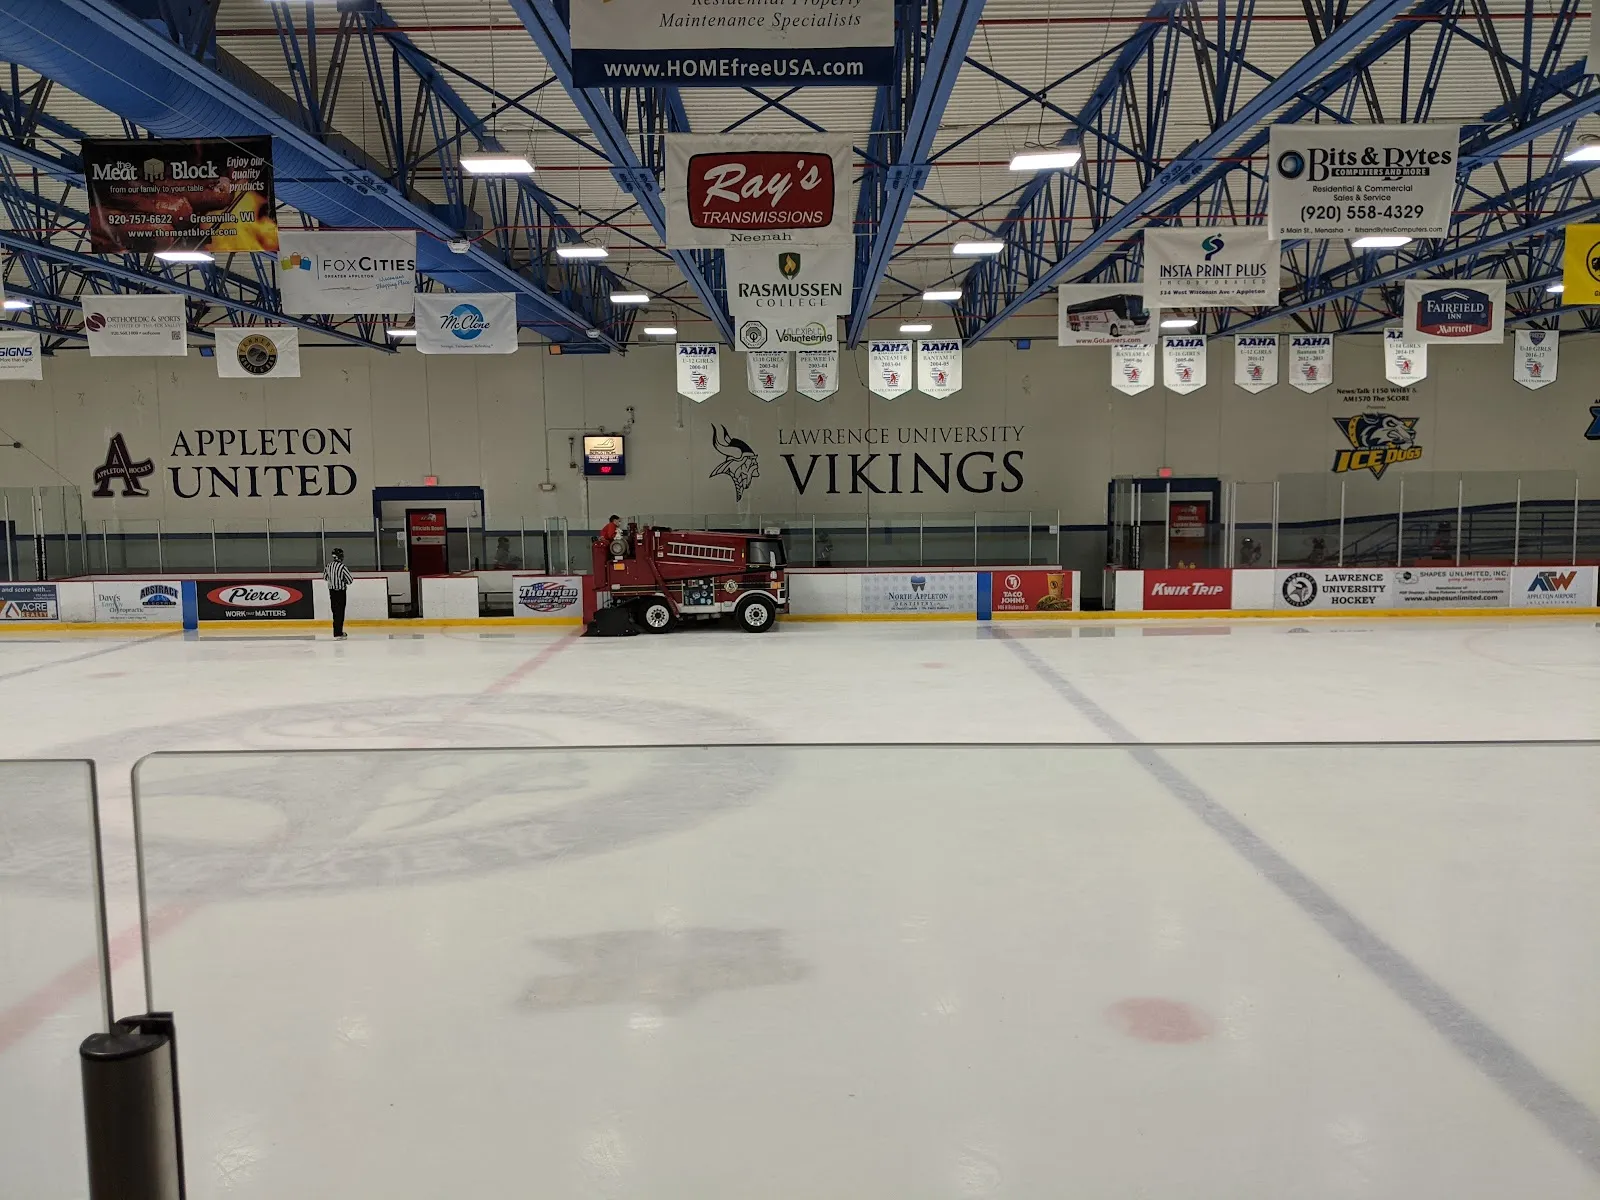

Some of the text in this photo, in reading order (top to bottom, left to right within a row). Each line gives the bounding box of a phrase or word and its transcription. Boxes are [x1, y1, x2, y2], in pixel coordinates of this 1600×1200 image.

[659, 12, 862, 31] Maintenance Specialists
[603, 58, 865, 77] www.HOMEfreeUSA.com
[117, 161, 131, 171] the
[226, 156, 266, 169] Enjoy our
[1306, 147, 1452, 182] Bits & Bytes
[92, 161, 219, 181] Meat Block
[231, 168, 260, 180] quality
[1335, 168, 1427, 176] COMPUTERS AND MORE
[110, 184, 127, 192] from
[139, 184, 160, 194] family
[171, 186, 187, 194] your
[187, 184, 204, 192] table
[229, 181, 265, 194] products
[703, 159, 823, 208] Ray's
[1312, 184, 1355, 192] Residential
[1364, 184, 1413, 192] Commercial
[1333, 194, 1392, 202] Sales & Service
[109, 211, 255, 225] 920-757-6622 Greenville, WI
[702, 211, 823, 224] TRANSMISSIONS
[1301, 205, 1425, 223] (920) 558-4329
[128, 228, 238, 238] www.themeatblock.com
[1354, 226, 1443, 234] BitsandBytesComputers.com
[730, 232, 792, 242] Neenah
[1160, 263, 1267, 278] INSTA PRINT PLUS
[738, 283, 842, 297] RASMUSSEN
[756, 298, 829, 307] COLLEGE
[1426, 300, 1485, 314] FAIRFIELD
[440, 314, 491, 330] McClone
[1436, 324, 1472, 334] Marriott
[775, 329, 834, 343] Volunteering
[1237, 337, 1277, 346] AAHA
[1291, 337, 1331, 346] AAHA
[871, 343, 910, 353] AAHA
[920, 342, 960, 352] AAHA
[1165, 338, 1205, 348] AAHA
[0, 347, 33, 357] SIGNS
[678, 346, 717, 355] AAHA
[779, 426, 1026, 445] LAWRENCE UNIVERSITY
[170, 427, 353, 457] APPLETON
[1331, 449, 1386, 474] ICE
[1385, 446, 1423, 465] DOGS
[97, 463, 152, 480] APPLETON HOCKEY
[780, 450, 1026, 496] VIKINGS
[167, 464, 358, 499] UNITED
[1324, 573, 1385, 582] LAWRENCE
[1527, 571, 1578, 592] ATW
[139, 584, 179, 600] ABSTRACT
[229, 587, 281, 603] Pierce
[520, 586, 578, 598] Therrien
[1151, 582, 1225, 596] KWIK TRIP
[1321, 584, 1387, 594] UNIVERSITY
[98, 593, 121, 603] Davis
[888, 592, 949, 600] NORTH APPLETON
[1001, 597, 1026, 605] JOHN'S
[1331, 596, 1377, 605] HOCKEY
[21, 602, 47, 611] ACRE
[255, 609, 287, 617] MATTERS
